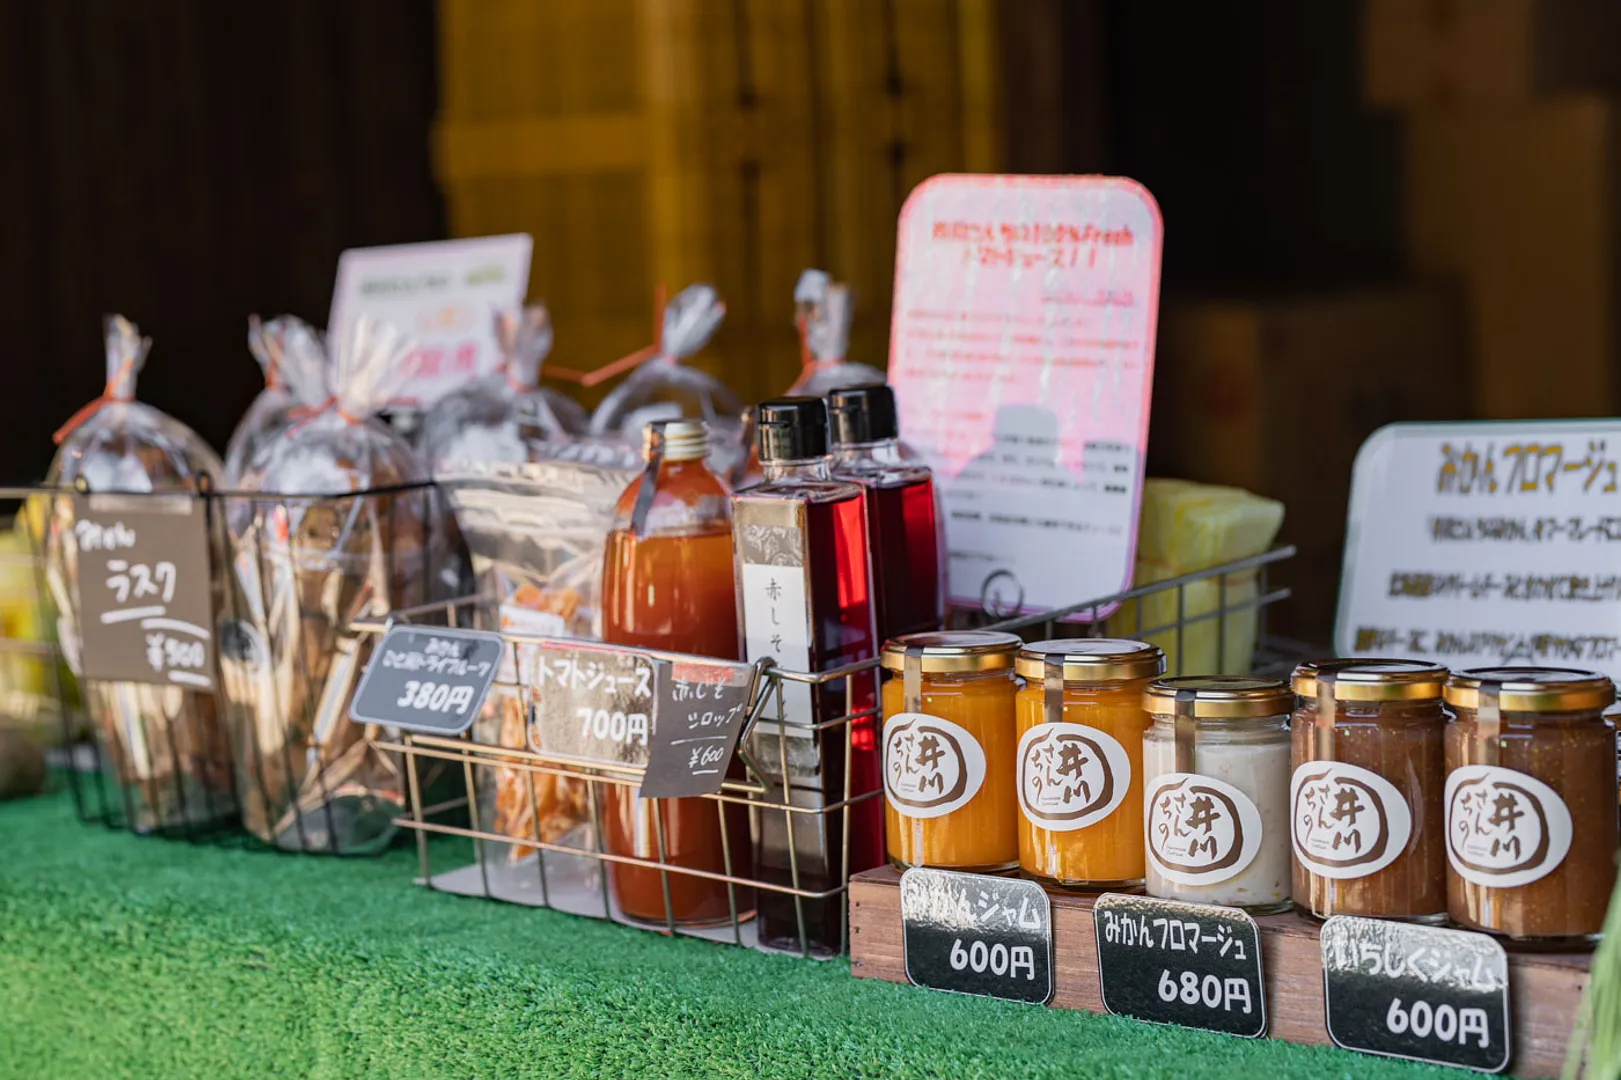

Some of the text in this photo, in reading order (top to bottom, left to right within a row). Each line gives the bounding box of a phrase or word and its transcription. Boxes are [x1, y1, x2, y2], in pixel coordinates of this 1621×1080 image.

[106, 559, 176, 603] ラスク
[397, 680, 474, 714] 380円
[539, 655, 651, 697] トマトジュース
[576, 707, 648, 746] 700円
[688, 746, 724, 769] ¥600
[1104, 911, 1247, 960] みかんフロマージュ
[950, 938, 1035, 980] 600円
[1158, 969, 1252, 1014] 680円
[1386, 998, 1489, 1049] 600円
